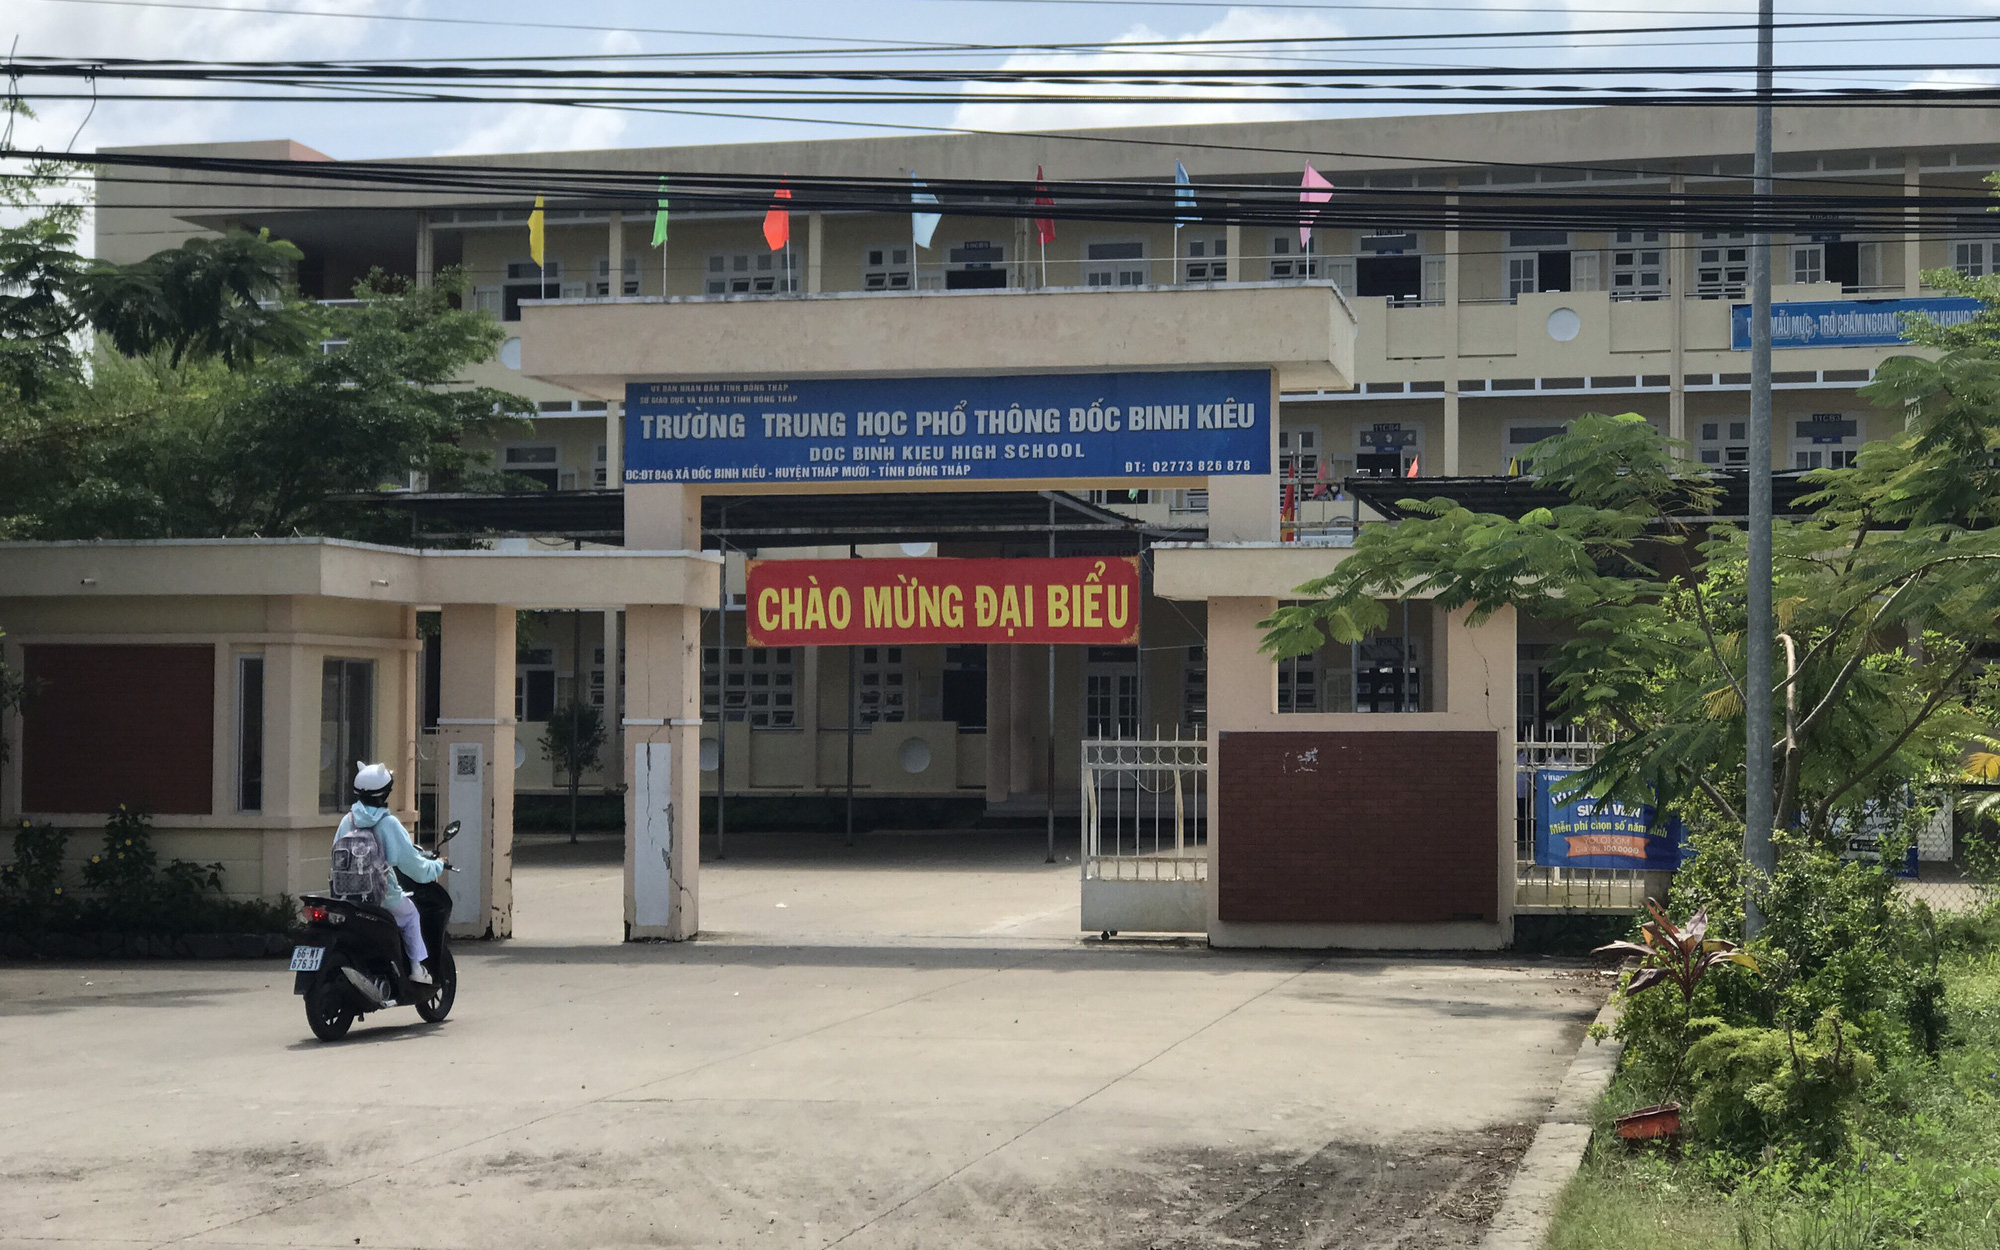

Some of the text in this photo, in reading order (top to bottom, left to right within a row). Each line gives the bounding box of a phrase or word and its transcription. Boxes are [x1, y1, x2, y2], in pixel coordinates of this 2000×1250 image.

[640, 406, 746, 439] TRƯỜNG
[762, 412, 846, 438] TRUNG
[857, 411, 907, 443] HỌC
[916, 400, 967, 436] PHỔ
[974, 403, 1060, 434] THÔNG
[1069, 398, 1121, 432] ĐỐC
[1129, 404, 1190, 431] BINH
[809, 443, 1085, 462] DOC BINH KIEU HIGH SCHOOL
[675, 467, 689, 480] XÃ
[714, 468, 739, 479] BINH
[775, 465, 810, 480] HUYỆN
[812, 463, 839, 478] THÁP
[941, 462, 971, 476] THÁP
[1125, 460, 1251, 472] ĐT: 02773 826 878
[758, 560, 1128, 637] CHÀO MỪNG ĐẠI BIỂU
[1550, 819, 1668, 838] Miễn phí chọn số năm sinh
